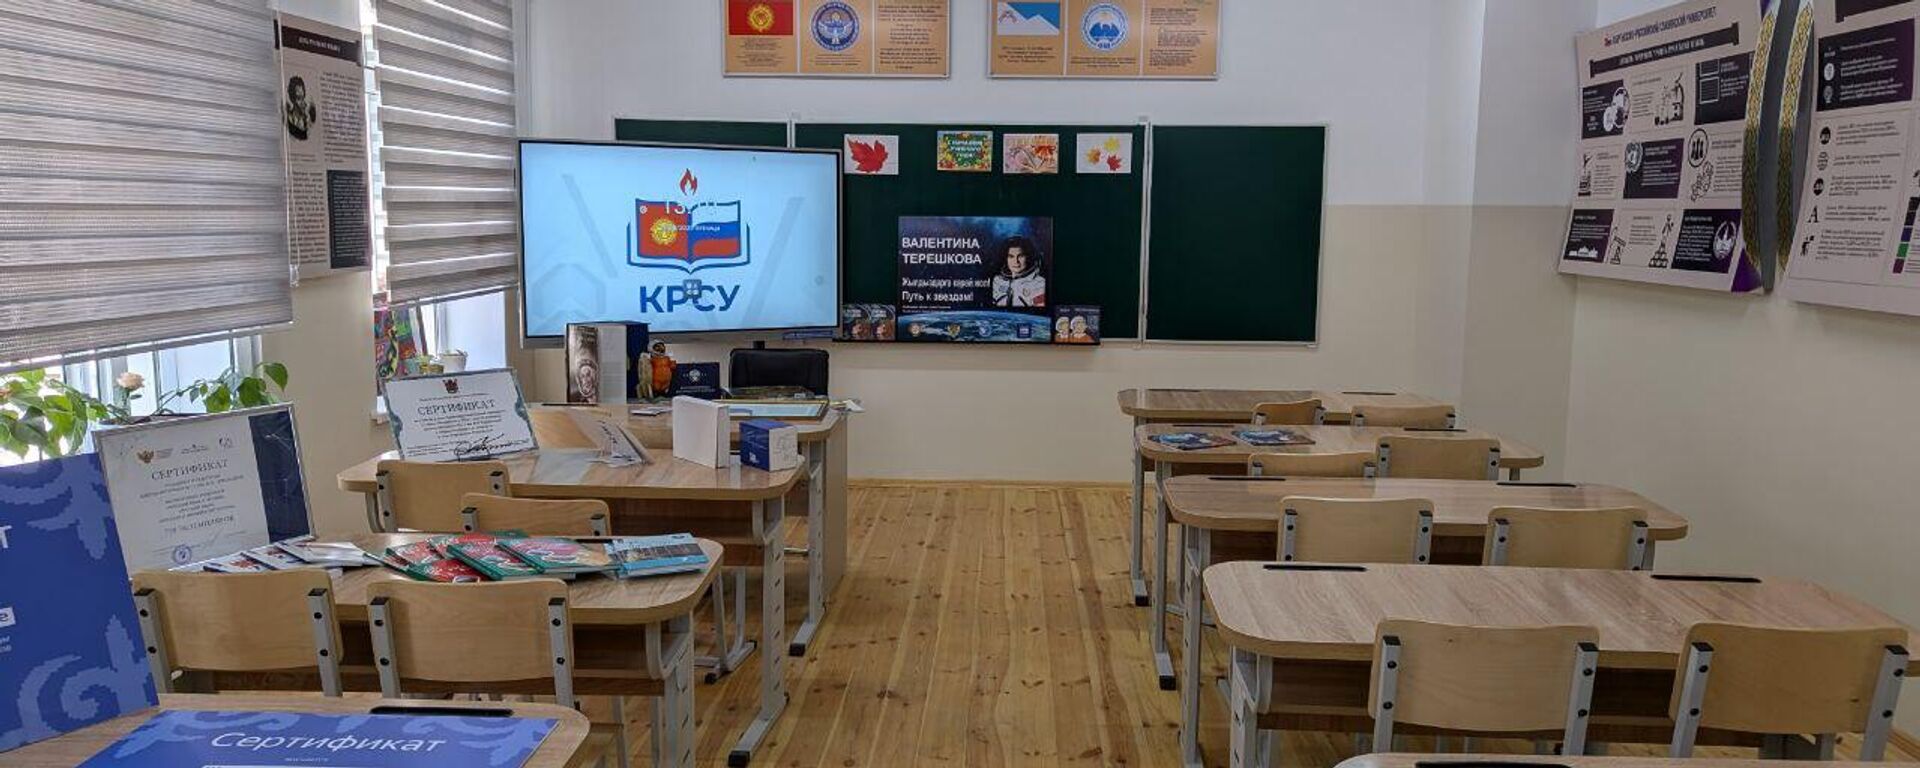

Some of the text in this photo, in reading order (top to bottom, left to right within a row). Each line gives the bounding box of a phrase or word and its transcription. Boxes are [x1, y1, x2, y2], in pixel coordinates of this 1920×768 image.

[902, 237, 980, 249] ВАЛЕНТИНА
[902, 253, 982, 265] ТЕРЕШКОВА
[640, 284, 741, 313] КРСУ
[902, 290, 974, 303] Путь к звездам!
[417, 399, 496, 416] СЕРТИФИКАТ
[151, 459, 229, 481] СЕРТИФИКАТ
[211, 731, 447, 752] Сертификат
